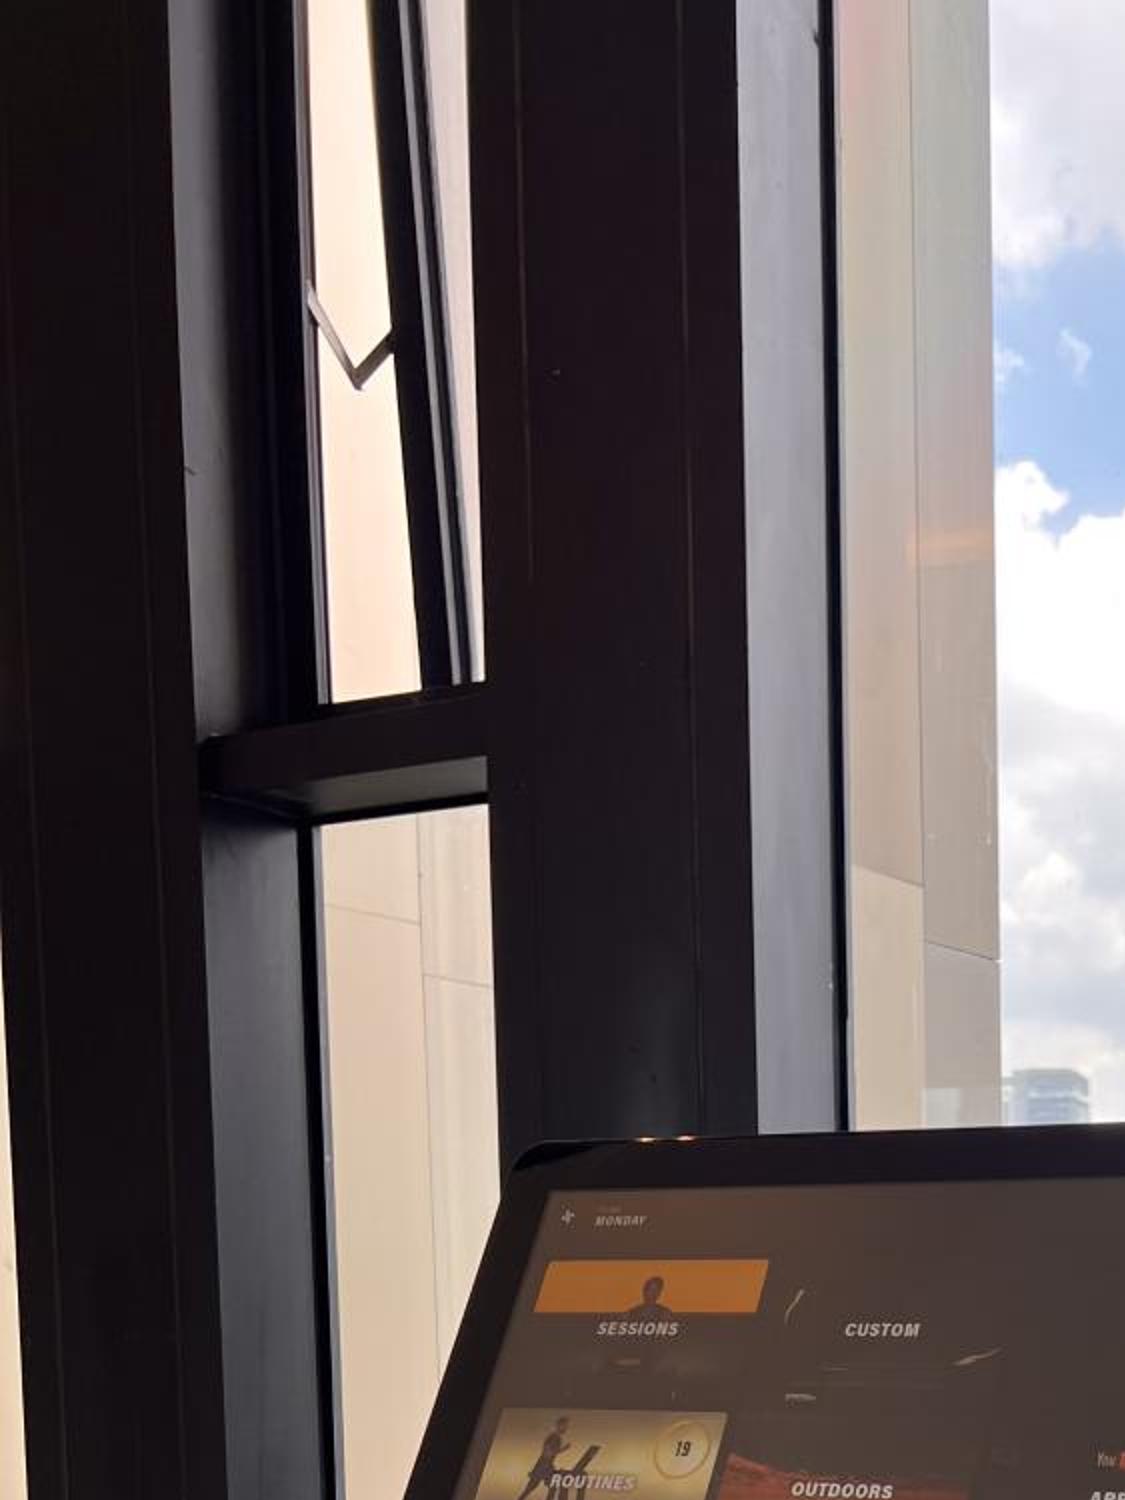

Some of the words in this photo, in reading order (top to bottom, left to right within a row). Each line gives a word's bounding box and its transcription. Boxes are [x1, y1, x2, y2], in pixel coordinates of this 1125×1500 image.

[594, 1215, 648, 1227] MONDAY
[597, 1321, 680, 1337] SESSIONS
[845, 1322, 921, 1338] CUSTOM
[674, 1440, 692, 1457] 19
[550, 1473, 636, 1491] ROUTINES
[791, 1481, 894, 1500] OUTDOORS
